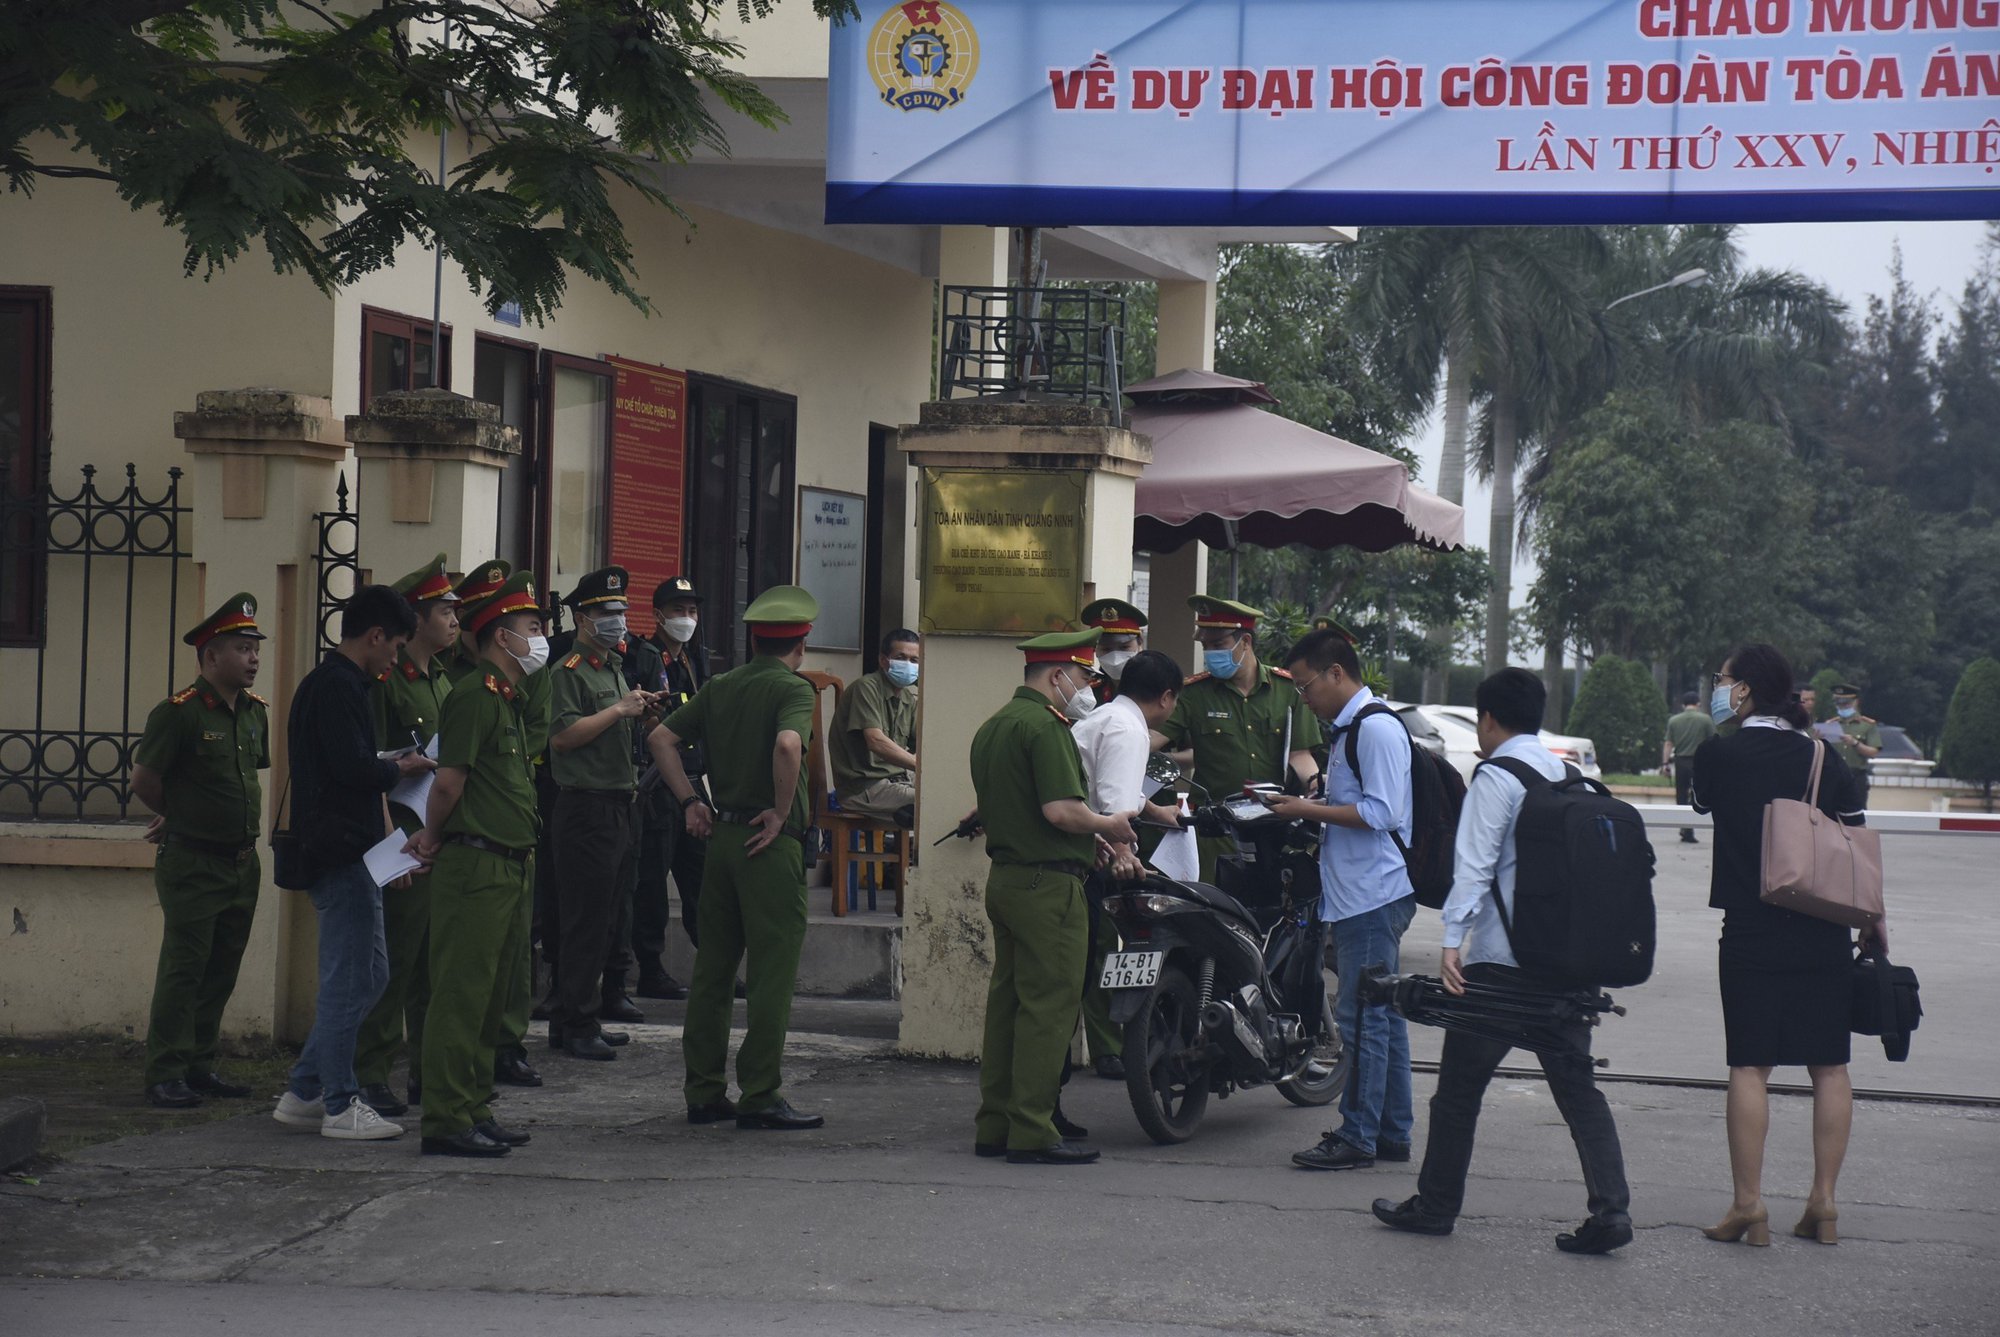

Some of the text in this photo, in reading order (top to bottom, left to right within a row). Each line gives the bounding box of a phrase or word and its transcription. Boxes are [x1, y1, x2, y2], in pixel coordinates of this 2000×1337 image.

[1049, 46, 2000, 118] VỀ DỰ ĐẠI HỘI CÔNG ĐOÀN TÒA ÁN
[903, 94, 942, 108] CĐVN
[1495, 120, 1599, 172] LẦN
[1612, 124, 1723, 171] THỨ
[1733, 133, 1857, 175] XXV,
[1054, 513, 1073, 529] NINH
[1115, 953, 1154, 970] 14-B1
[1103, 969, 1156, 987] 516.45
